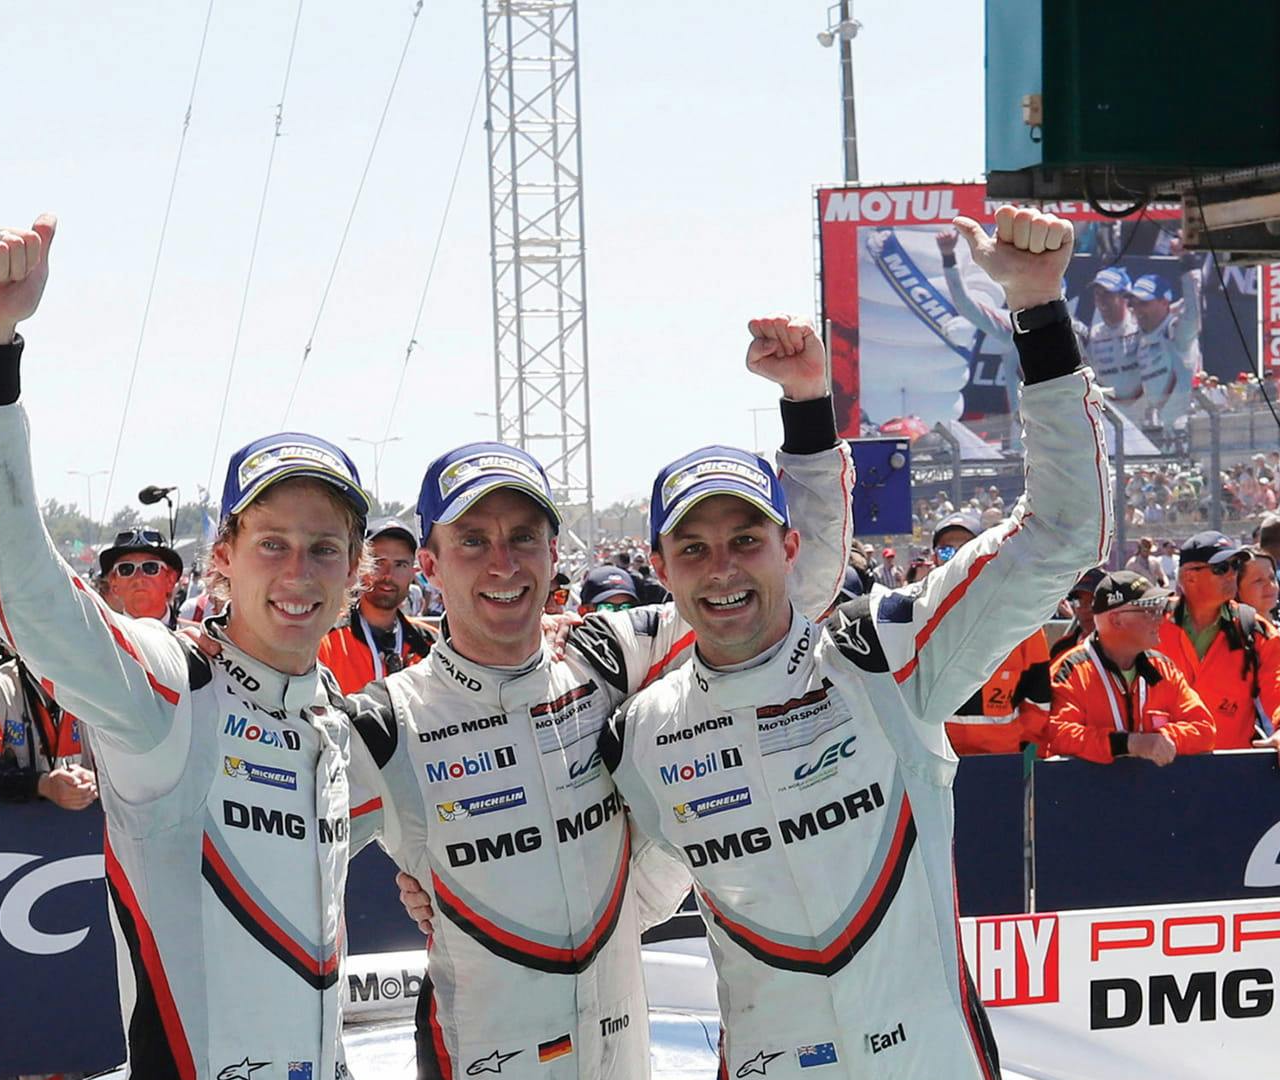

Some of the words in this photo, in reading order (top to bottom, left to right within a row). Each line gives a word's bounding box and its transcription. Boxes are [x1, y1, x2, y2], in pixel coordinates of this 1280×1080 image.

[824, 190, 960, 222] MOTUL
[418, 722, 460, 744] DMG
[462, 713, 508, 734] MORI
[656, 726, 695, 746] DMG
[694, 715, 734, 737] MORI
[758, 700, 832, 732] MOTORSPORT
[285, 730, 300, 752] 1
[250, 768, 296, 785] MICHELIN
[425, 751, 492, 783] Mobil
[497, 747, 515, 769] 1
[660, 751, 718, 786] Mobil
[722, 748, 741, 769] 1
[469, 791, 524, 811] MICHELIN
[696, 791, 750, 813] MICHELIN
[223, 799, 306, 841] DMG
[683, 826, 772, 868] DMG
[778, 782, 886, 845] MORI
[445, 826, 543, 868] DMG
[1090, 966, 1275, 1031] DMG
[599, 1013, 630, 1038] Timo
[870, 1022, 908, 1055] Earl
